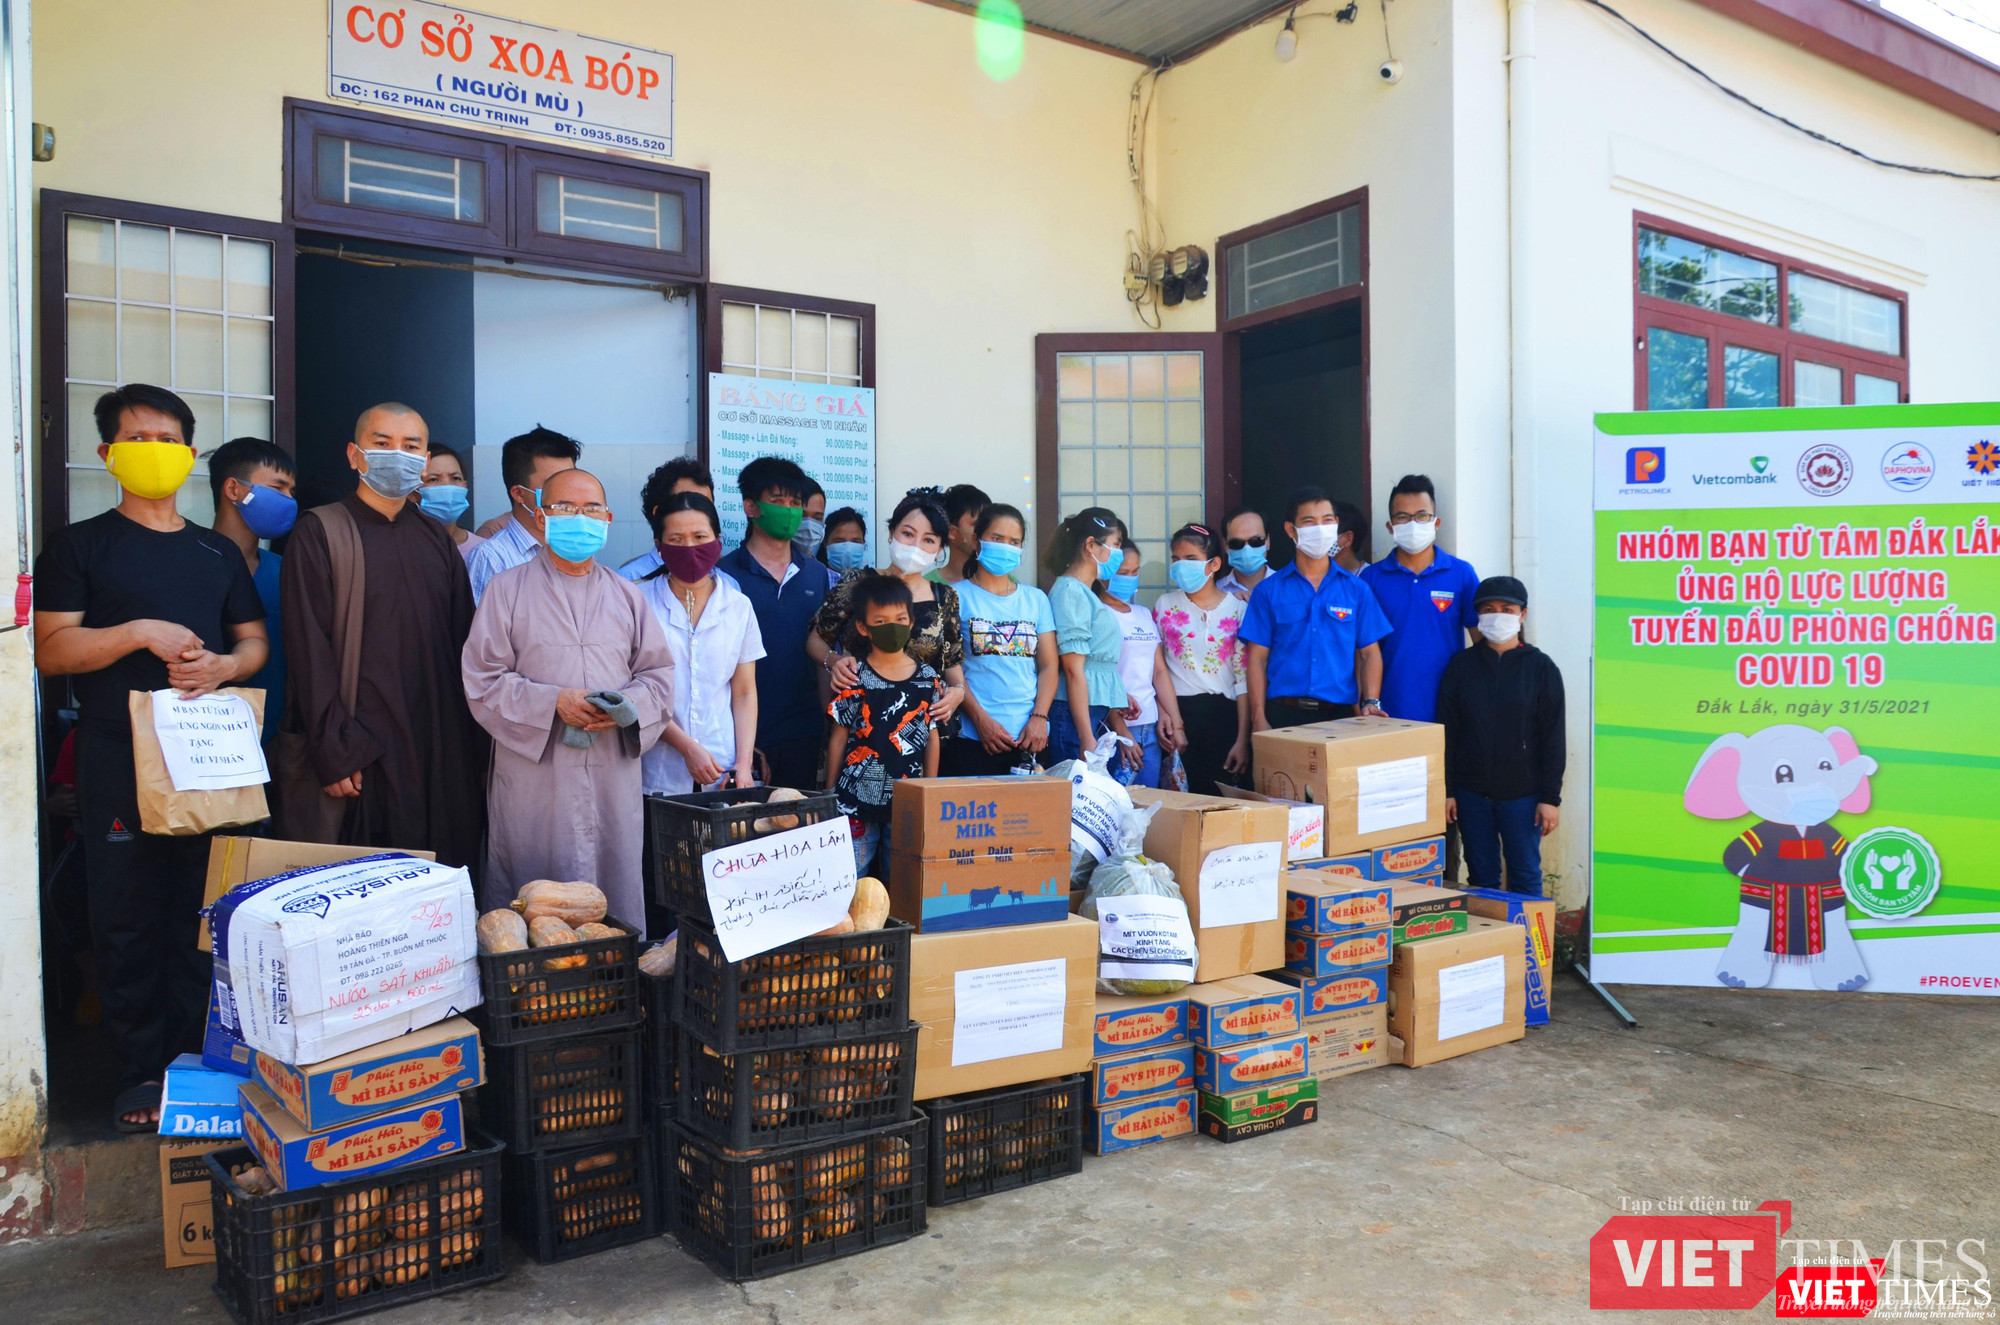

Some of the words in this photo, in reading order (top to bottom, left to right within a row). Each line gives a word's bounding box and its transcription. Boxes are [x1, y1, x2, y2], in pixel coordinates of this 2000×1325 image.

[346, 5, 406, 49] CƠ
[420, 13, 474, 63] SỞ
[489, 34, 573, 85] XOA
[585, 52, 659, 100] BÓP
[451, 74, 528, 105] NGƯỜI
[535, 91, 569, 112] MÙ
[340, 83, 368, 97] ĐC:
[373, 89, 399, 102] 162
[404, 95, 446, 111] PHAN
[450, 103, 480, 117] CHU
[486, 109, 530, 126] TRINH
[554, 121, 577, 136] ĐT:
[580, 128, 665, 152] 0935.855.520
[718, 381, 807, 412] BẢNG
[815, 393, 868, 418] GIÁ
[760, 415, 818, 428] MASSAGE
[820, 420, 832, 430] VI
[722, 430, 749, 444] Massage
[825, 438, 853, 449] 90.000/60
[854, 440, 868, 451] Phút
[722, 448, 749, 461] Massage
[823, 455, 853, 466] 110.000/60
[854, 457, 868, 467] Phút
[823, 472, 853, 483] 120.000/60
[854, 474, 868, 484] Phút
[1693, 472, 1777, 485] Vietcombank
[1884, 466, 1932, 475] DAPHOVINA
[854, 491, 868, 501] Phút
[1619, 487, 1672, 495] PETROLIMEX
[1619, 526, 1700, 560] NHÓM
[1710, 531, 1767, 564] BẠN
[1777, 525, 1813, 557] TỪ
[1819, 525, 1878, 557] TÂM
[1888, 518, 1946, 555] ĐẮK
[1678, 566, 1735, 601] ỦNG
[1744, 569, 1780, 606] HỘ
[1791, 571, 1843, 606] LỰC
[1853, 568, 1946, 605] LƯỢNG
[1631, 609, 1717, 644] TUYẾN
[1727, 607, 1781, 644] ĐẦU
[1792, 613, 1888, 643] PHÒNG
[1898, 605, 1995, 643] CHỐNG
[1738, 655, 1832, 686] COVID
[1844, 655, 1883, 686] 19
[1696, 698, 1732, 714] Đắk
[1739, 698, 1778, 716] Lắk,
[1785, 700, 1833, 717] ngày
[1839, 699, 1930, 714] 31/5/2021
[939, 800, 998, 822] Dalat
[956, 823, 997, 840] Milk
[771, 840, 812, 860] HOA
[819, 830, 846, 849] LÂM
[949, 849, 975, 859] Dalat
[987, 846, 1014, 856] Dalat
[956, 858, 976, 866] Milk
[995, 855, 1014, 863] Milk
[1389, 862, 1398, 870] MÌ
[1331, 908, 1341, 919] MÌ
[1343, 904, 1358, 918] HẢI
[1359, 901, 1376, 915] SẢN
[1416, 905, 1433, 913] CHUA
[1433, 903, 1446, 911] CAY
[336, 934, 354, 946] NHÀ
[355, 929, 372, 940] BÁO
[337, 943, 367, 960] HOÀNG
[369, 937, 392, 951] THIÊN
[392, 933, 409, 944] NGA
[339, 964, 348, 973] 19
[382, 952, 393, 960] TP.
[394, 944, 414, 956] BUÔN
[426, 933, 448, 947] THUỘC
[1330, 950, 1341, 961] MÌ
[1342, 946, 1358, 959] HẢI
[340, 976, 354, 986] ĐT.
[354, 971, 369, 981] 098
[371, 967, 385, 976] 222
[385, 961, 403, 972] 0265
[1360, 980, 1371, 990] MÌ
[352, 1003, 372, 1020] 25
[1226, 1017, 1238, 1029] MÌ
[1241, 1012, 1258, 1026] HẢI
[1261, 1009, 1281, 1024] SẢN
[1107, 1031, 1120, 1043] MÌ
[1122, 1026, 1140, 1041] HẢI
[1142, 1022, 1163, 1036] SẢN
[1117, 1019, 1135, 1028] Phúc
[1146, 1066, 1165, 1083] HẢI
[1167, 1064, 1180, 1076] MÌ
[1236, 1065, 1249, 1078] MÌ
[1272, 1055, 1292, 1070] SẢN
[366, 1068, 395, 1084] Phúc
[1121, 1071, 1144, 1086] SẢN
[351, 1085, 371, 1105] MÌ
[375, 1078, 404, 1098] HẢI
[408, 1069, 441, 1090] SẢN
[1117, 1121, 1130, 1135] MÌ
[1133, 1116, 1152, 1132] HẢI
[1154, 1111, 1175, 1126] SẢN
[1236, 1125, 1252, 1136] CAY
[1254, 1119, 1274, 1132] CHUA
[1276, 1117, 1286, 1127] MÌ
[343, 1131, 374, 1149] Phúc
[328, 1153, 349, 1171] MÌ
[353, 1143, 383, 1164] HẢI
[387, 1134, 420, 1154] SẢN
[183, 1222, 197, 1242] 6
